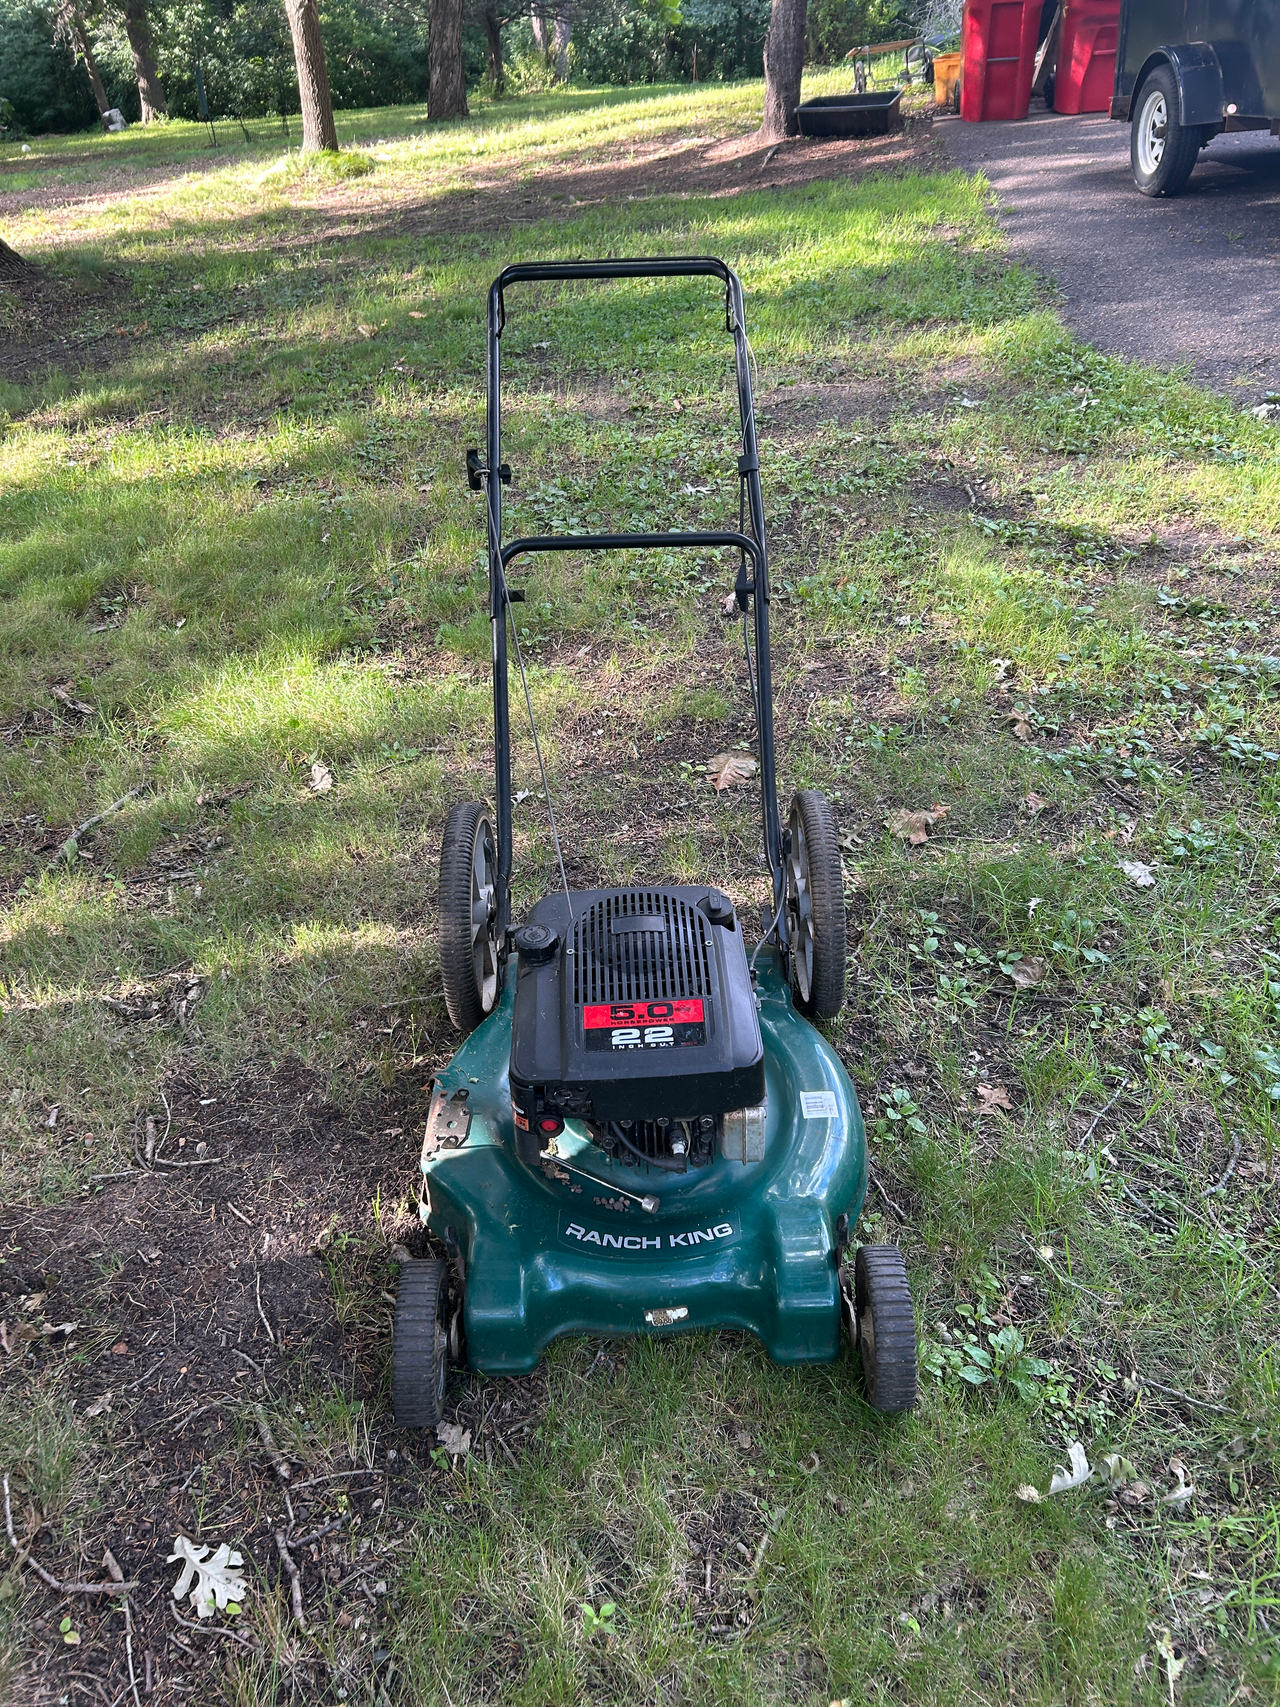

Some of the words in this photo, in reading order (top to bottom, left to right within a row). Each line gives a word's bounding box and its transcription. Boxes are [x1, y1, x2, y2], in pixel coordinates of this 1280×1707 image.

[611, 1003, 673, 1020] 5.0
[611, 1017, 674, 1025] HORSEPOWER
[611, 1026, 674, 1045] 22
[565, 1222, 661, 1250] RANCH
[669, 1222, 734, 1248] KING
